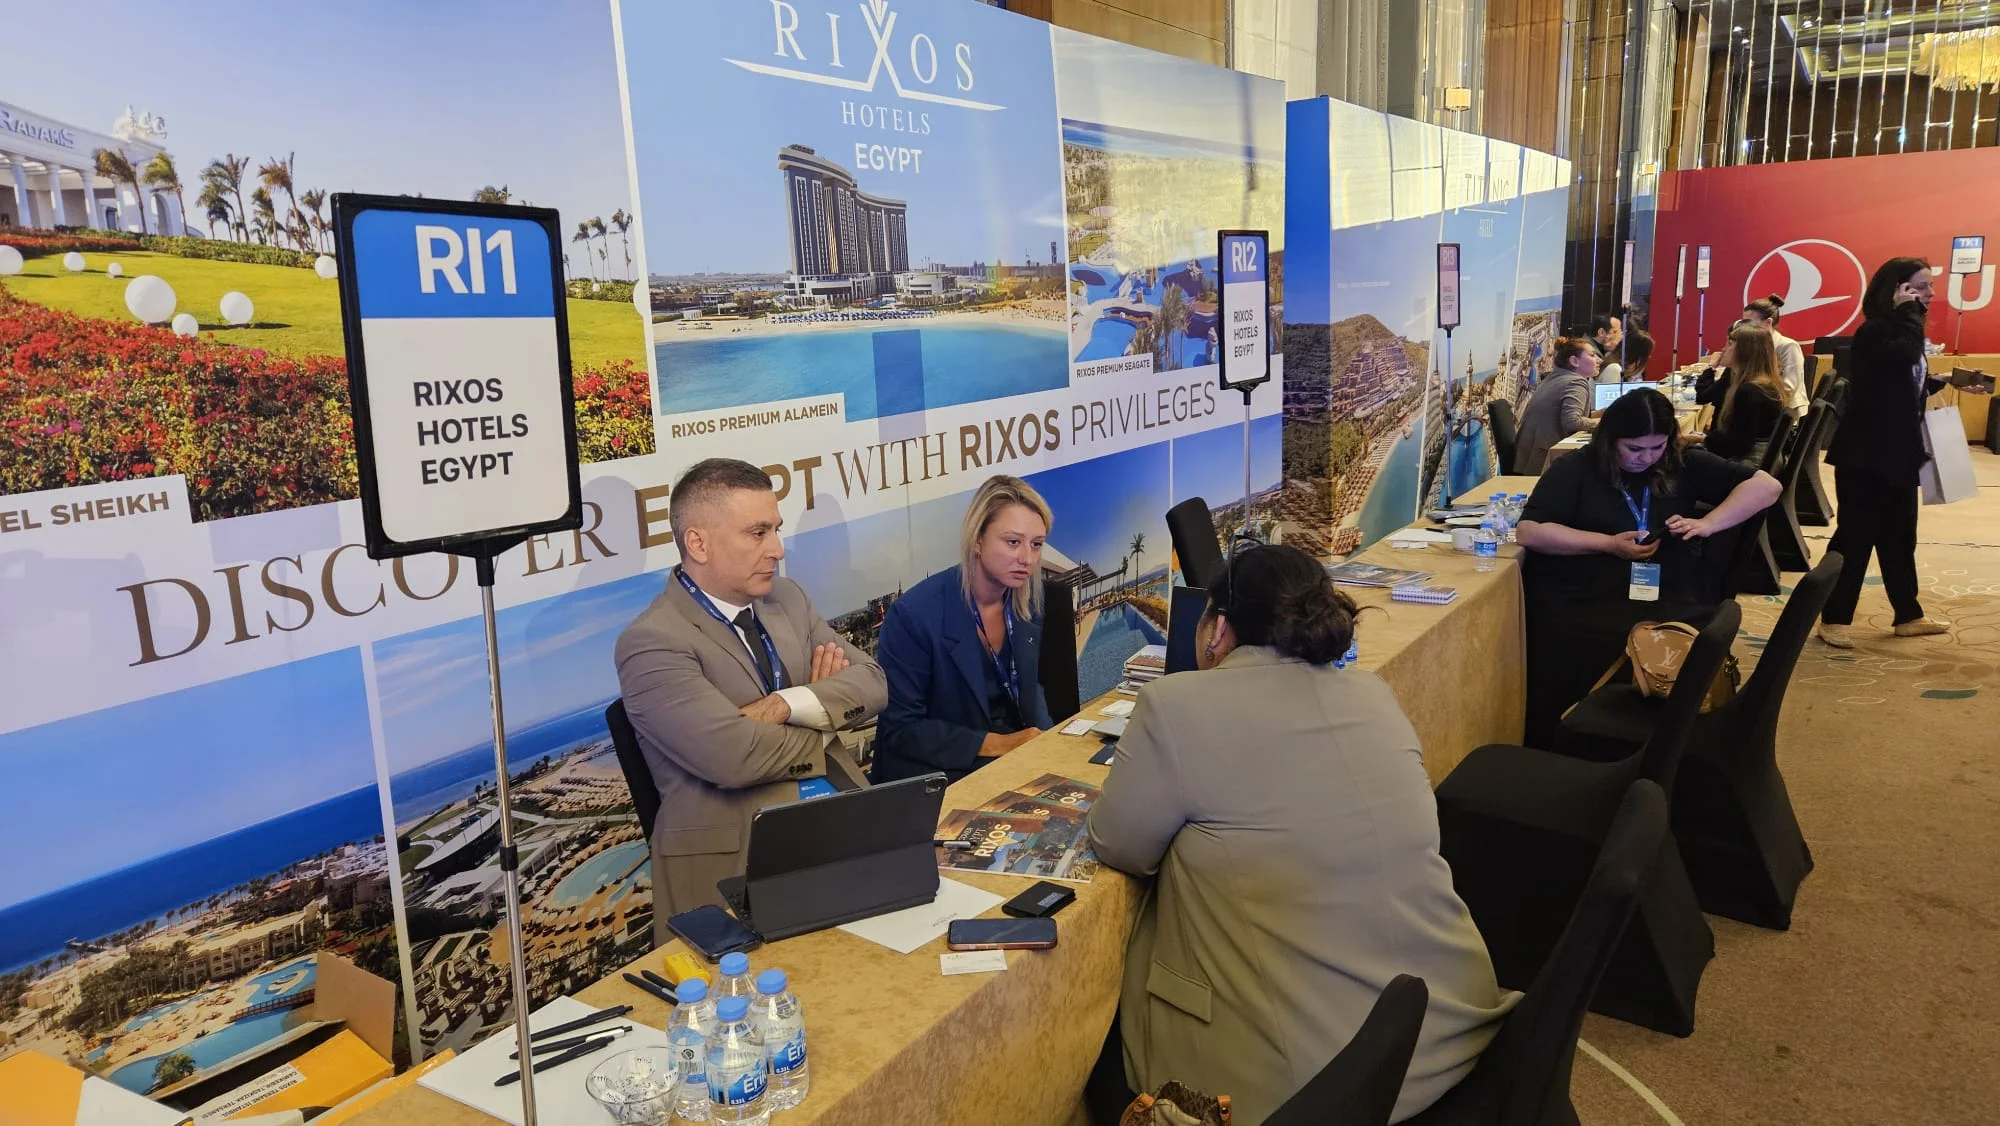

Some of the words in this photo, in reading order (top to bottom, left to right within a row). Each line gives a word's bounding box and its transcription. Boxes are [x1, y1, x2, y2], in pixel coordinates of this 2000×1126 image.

[769, 0, 975, 97] RIXOS
[840, 100, 931, 135] HOTELS
[855, 143, 923, 174] EGYPT
[415, 225, 517, 295] RI1
[1231, 241, 1257, 273] RI2
[1233, 309, 1254, 323] RIXOS
[1233, 326, 1259, 341] HOTELS
[1234, 343, 1255, 358] EGYPT
[1076, 366, 1096, 378] RIXOS
[1096, 363, 1124, 376] PREMIUM
[1124, 359, 1151, 371] SEAGATE
[413, 378, 504, 407] RIXOS
[417, 413, 529, 446] HOTELS
[671, 419, 716, 438] RIXOS
[720, 411, 781, 431] PREMIUM
[784, 402, 839, 423] ALAMEIN
[421, 451, 514, 485] EGYPT
[0, 509, 42, 534] EL
[51, 491, 170, 526] SHEIKH
[116, 501, 619, 668] DISCOER
[634, 455, 823, 550] EPT
[832, 431, 949, 500] WITH
[959, 409, 1061, 471] RIXOS
[1071, 380, 1216, 446] PRIVILEGES
[973, 823, 1012, 857] RIXOS
